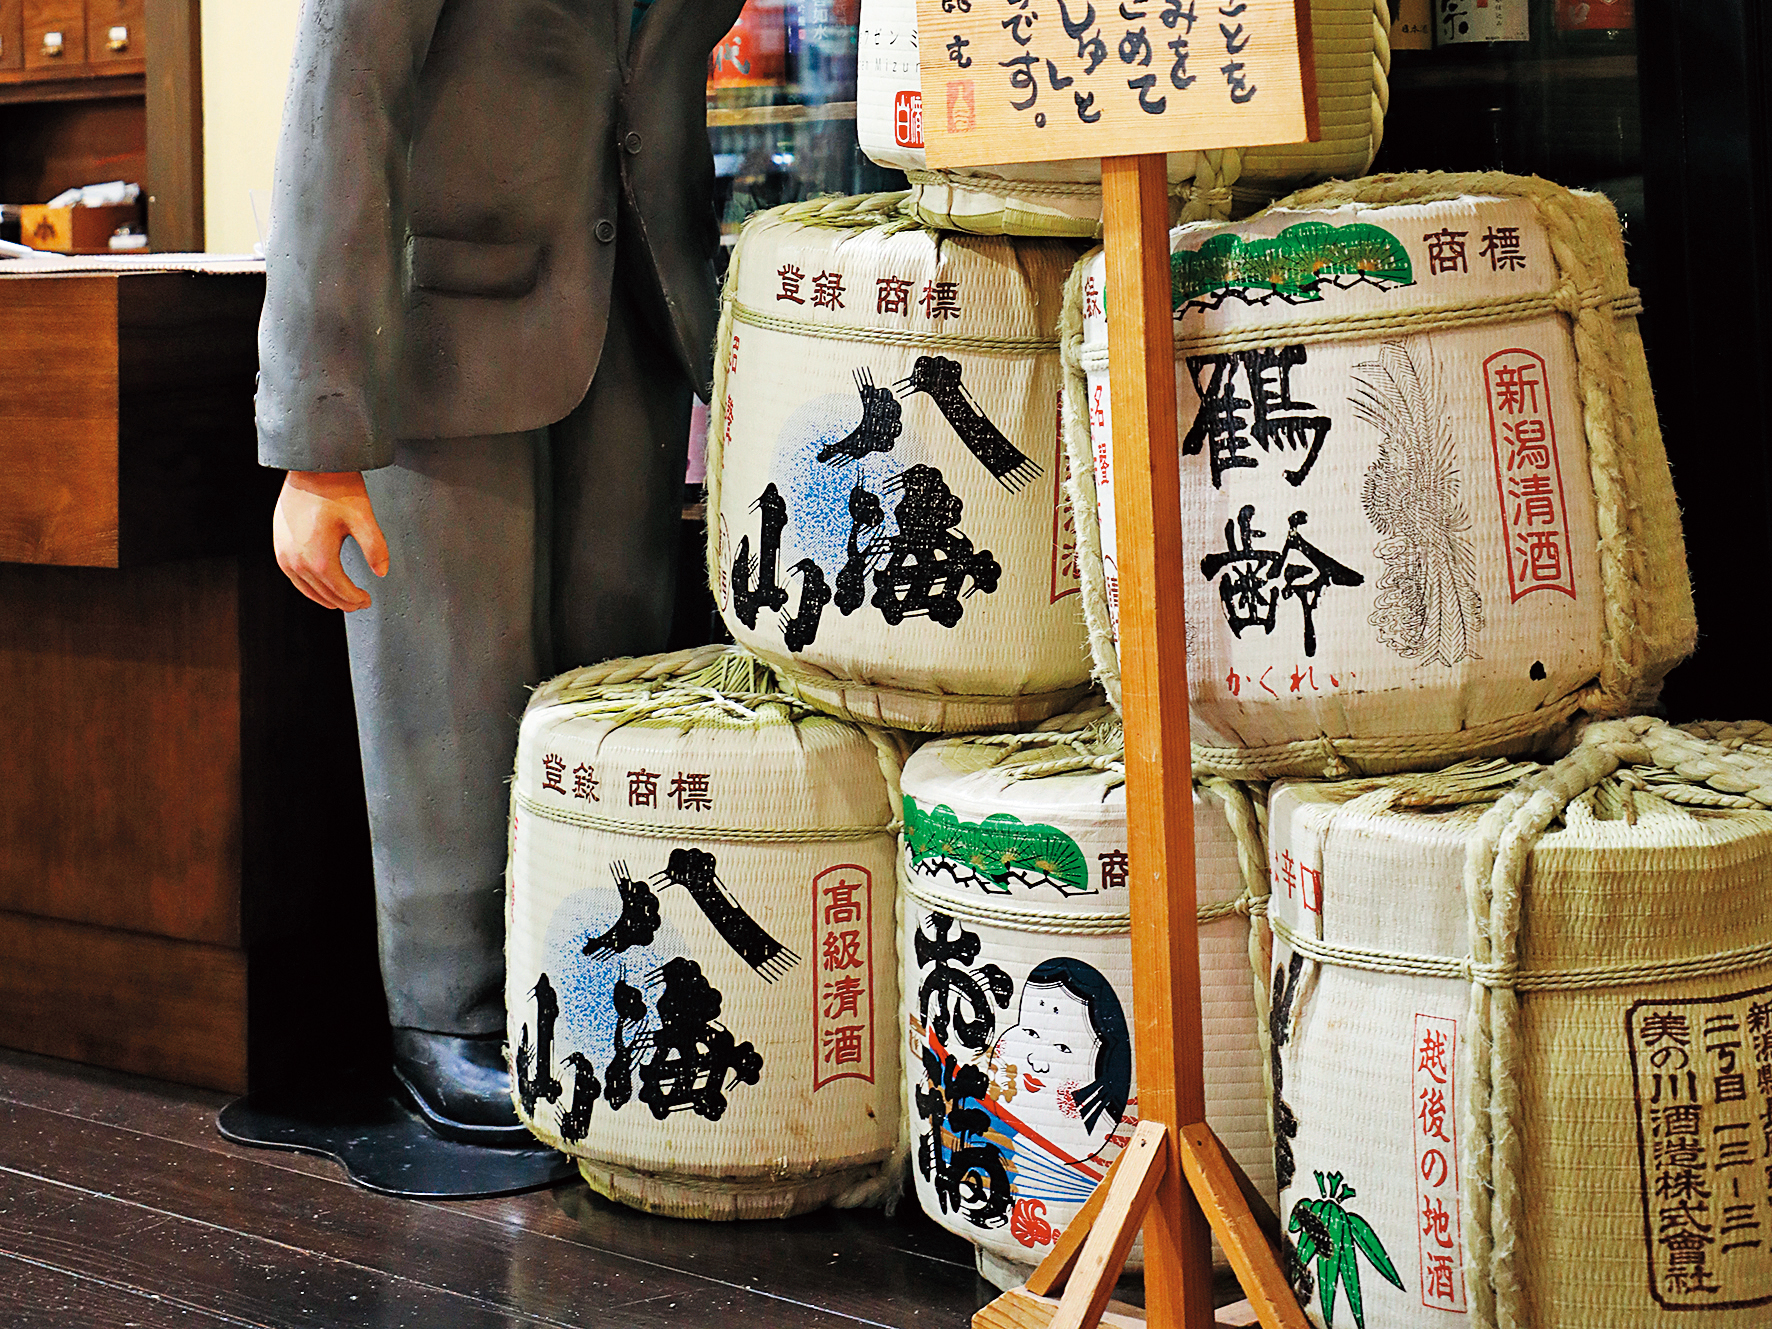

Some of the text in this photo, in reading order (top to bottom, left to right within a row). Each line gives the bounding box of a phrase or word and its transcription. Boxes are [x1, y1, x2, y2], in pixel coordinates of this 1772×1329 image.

[775, 263, 963, 321] 登録 商標
[1423, 225, 1530, 276] 商標
[730, 355, 1046, 653] 八海山
[1181, 344, 1365, 659] 鶴齢
[1493, 359, 1566, 586] 新潟清酒
[541, 752, 714, 813] 登録 商標
[1224, 662, 1357, 698] かくれい
[514, 846, 802, 1146] 八海山
[1416, 1029, 1457, 1303] 越後の地酒
